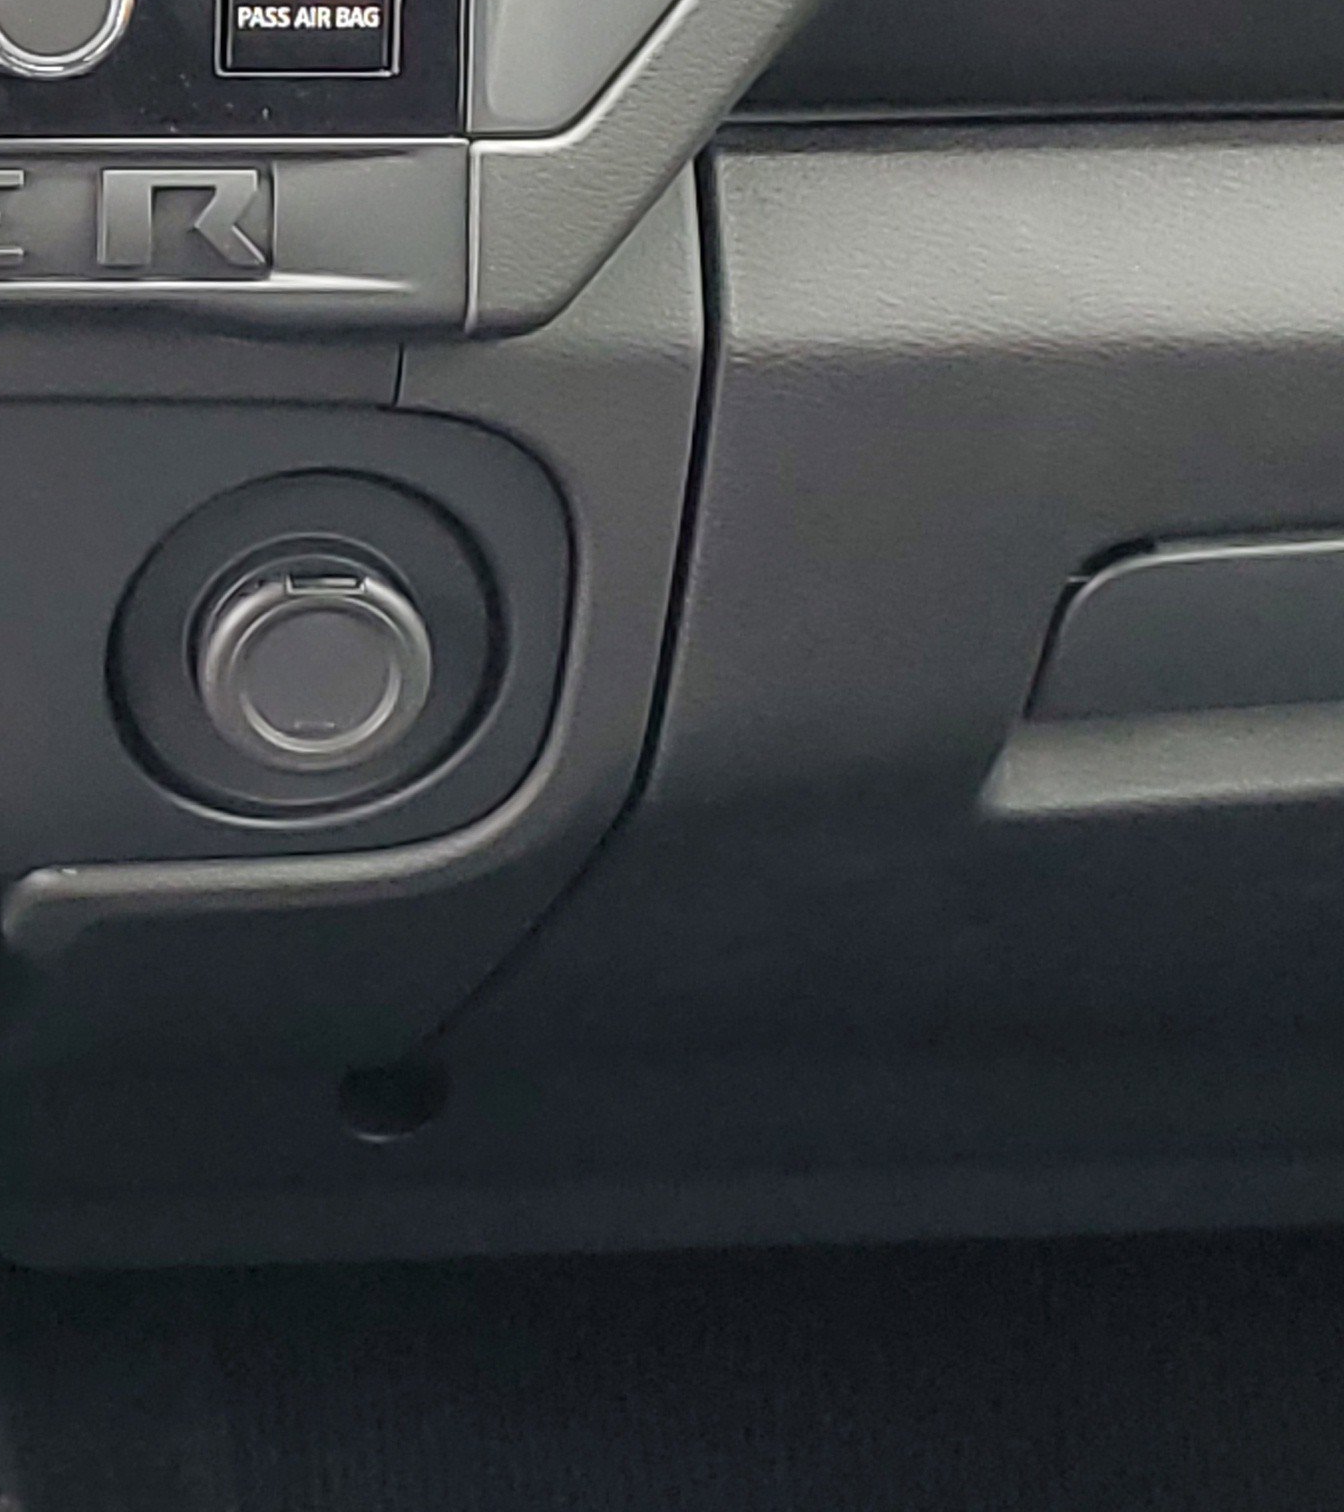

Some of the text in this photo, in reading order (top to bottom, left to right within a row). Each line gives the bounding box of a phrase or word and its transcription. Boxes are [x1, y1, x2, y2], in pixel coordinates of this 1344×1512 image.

[237, 6, 381, 29] PASS AIR BAG
